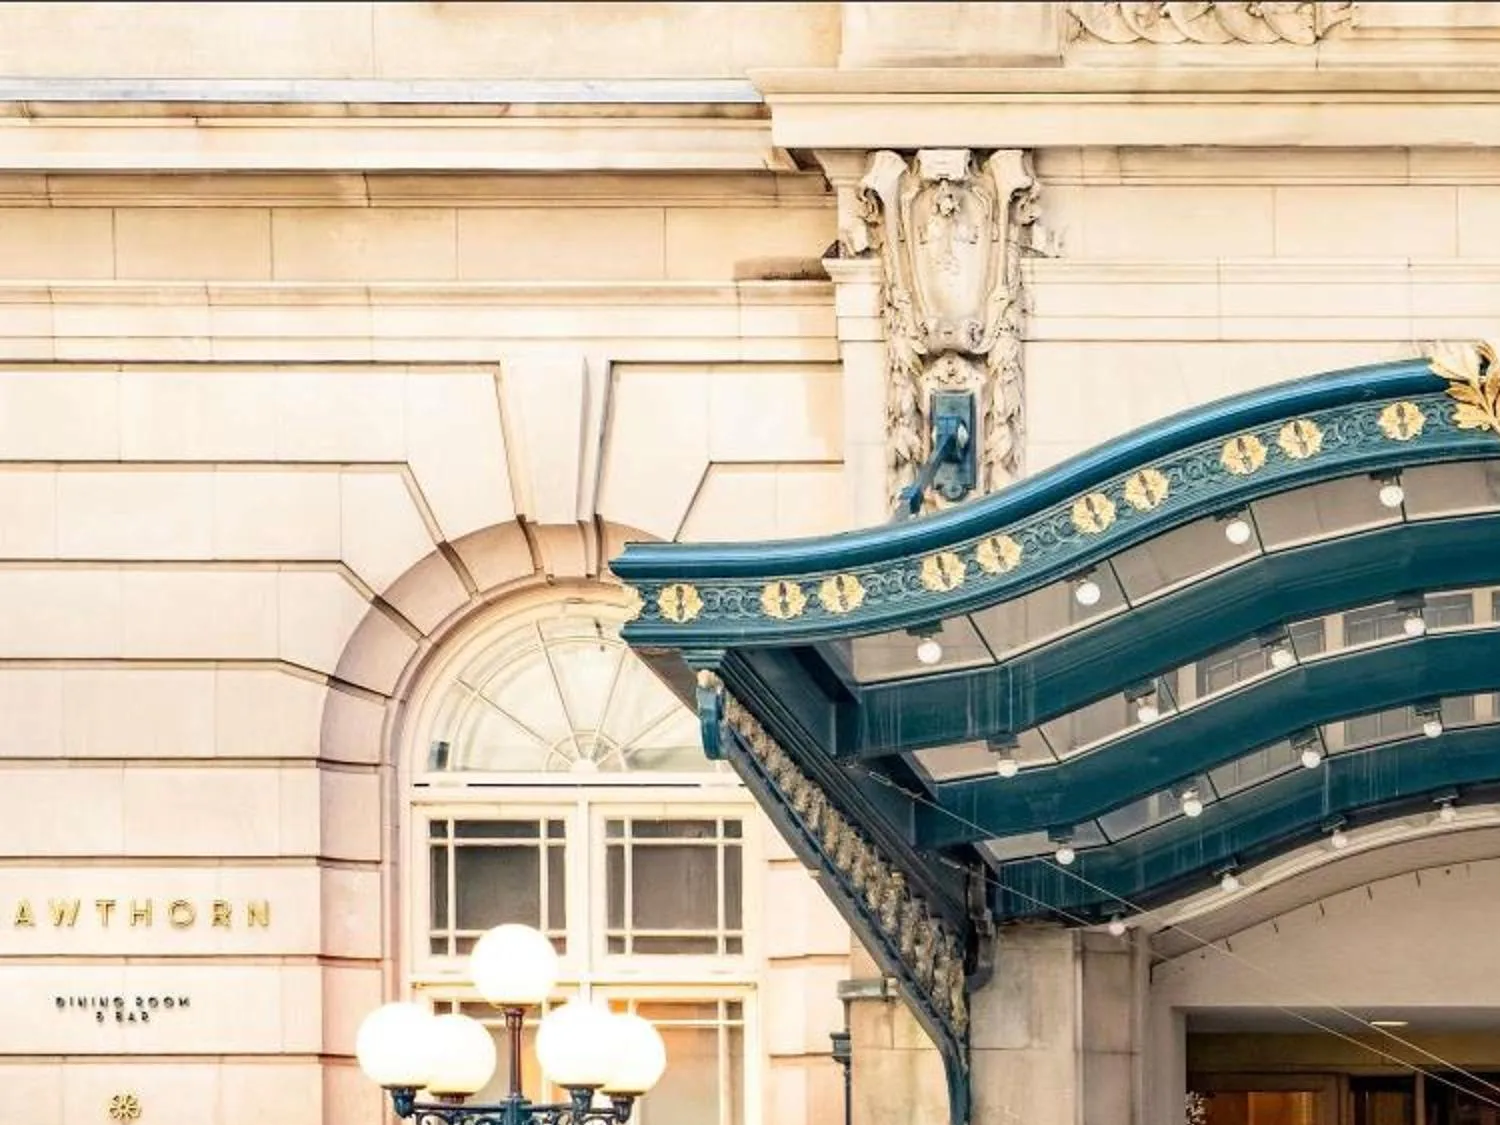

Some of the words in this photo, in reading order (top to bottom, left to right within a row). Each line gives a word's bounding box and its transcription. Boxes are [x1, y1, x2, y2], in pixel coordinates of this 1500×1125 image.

[13, 898, 270, 928] AWTHORN
[55, 996, 125, 1009] DINING
[135, 996, 190, 1009] ROOM
[115, 1010, 151, 1023] BAR
